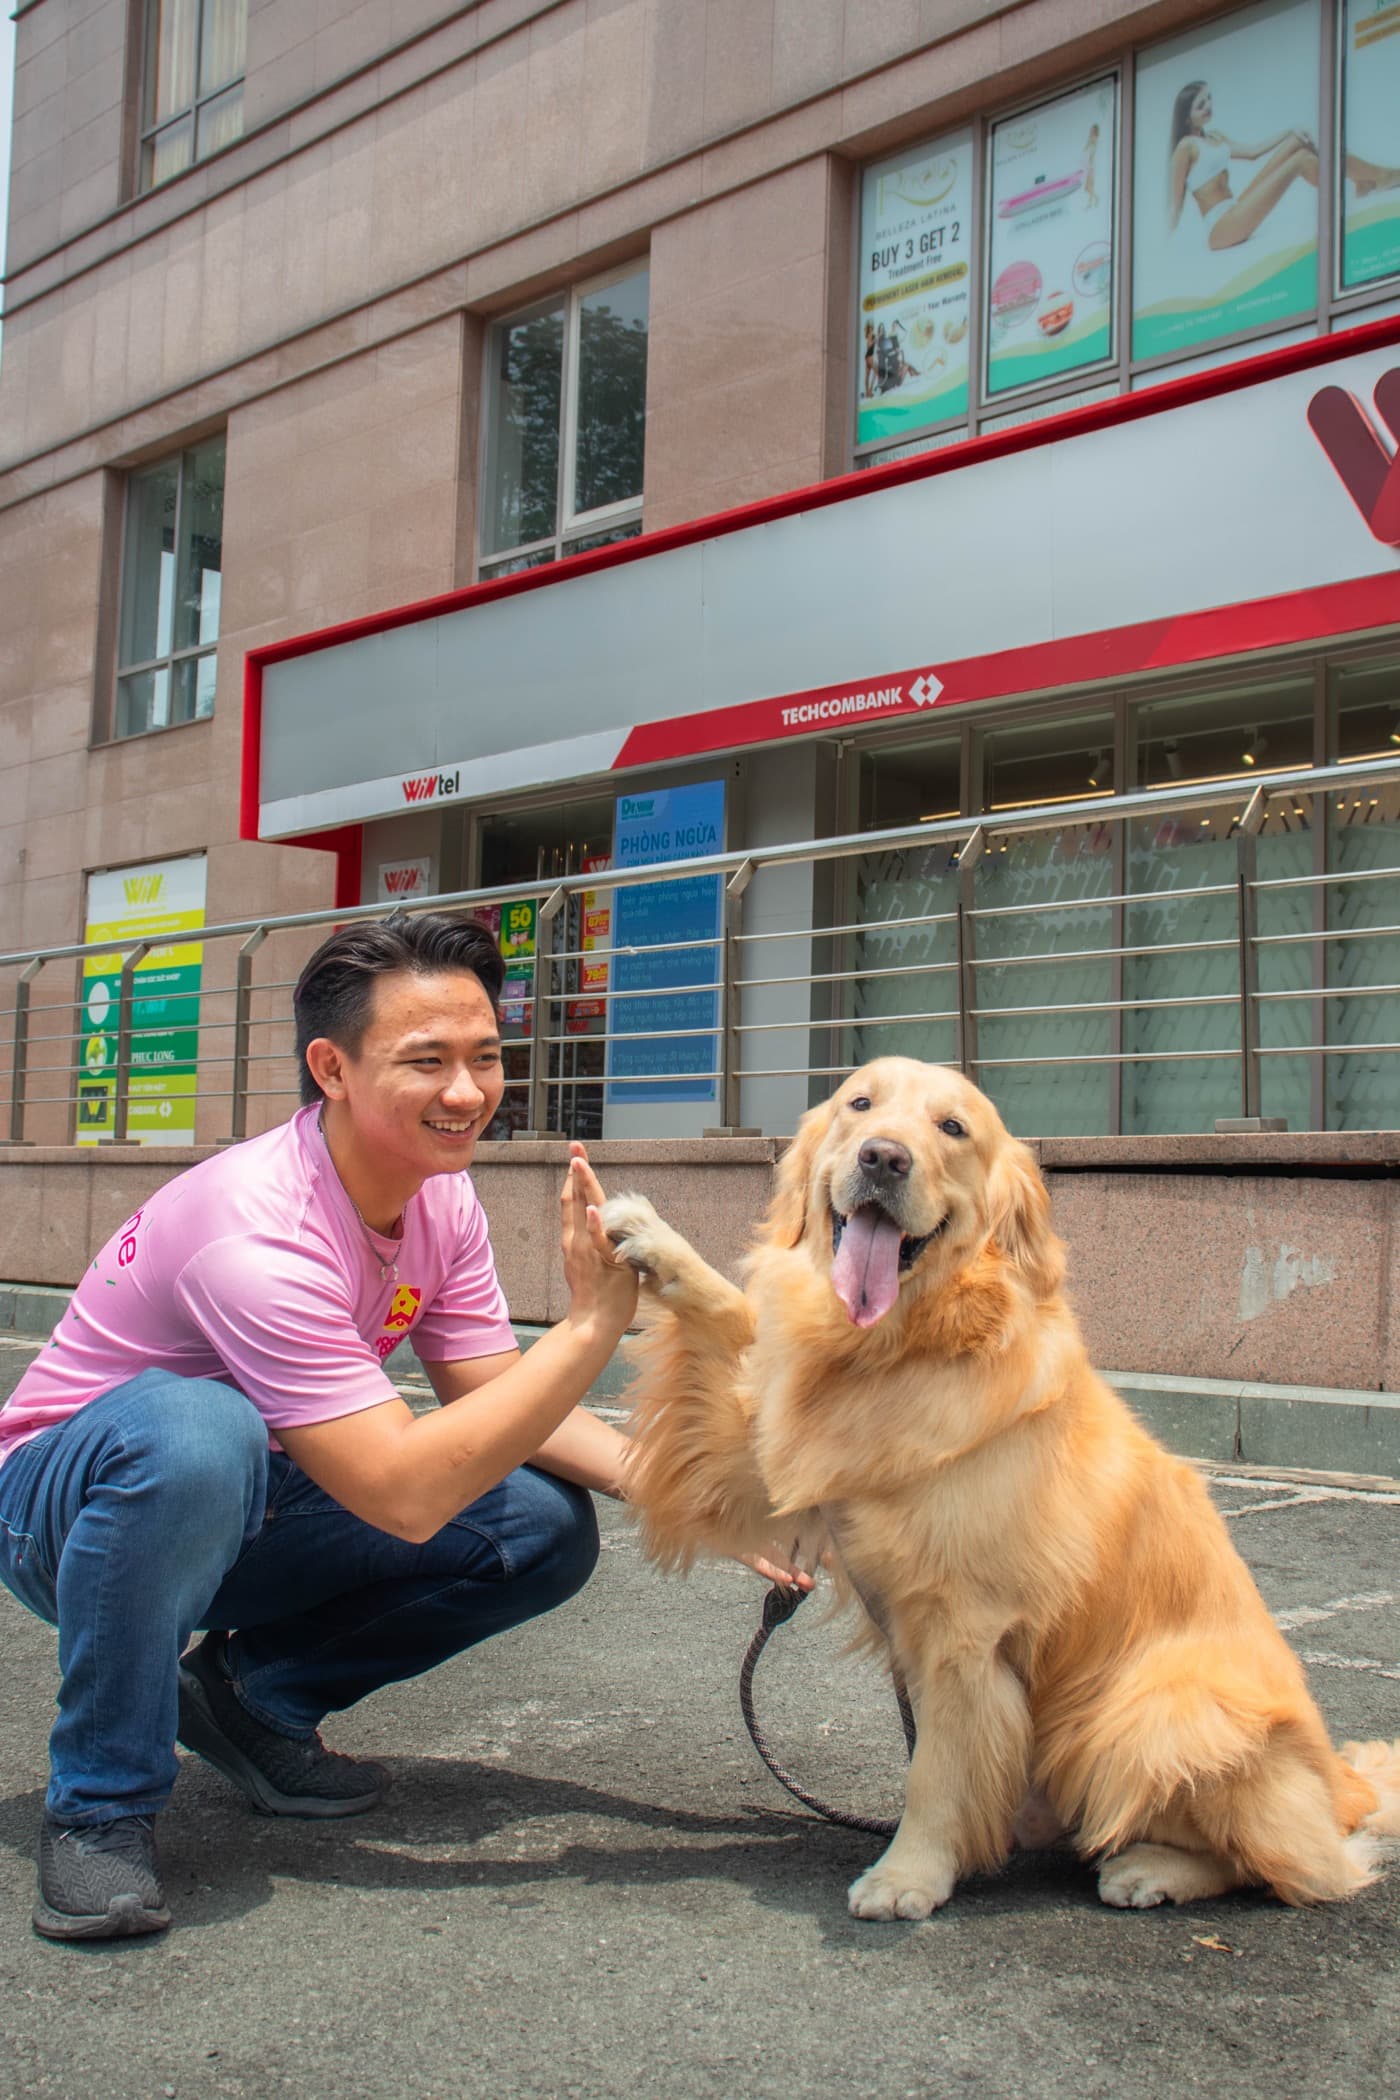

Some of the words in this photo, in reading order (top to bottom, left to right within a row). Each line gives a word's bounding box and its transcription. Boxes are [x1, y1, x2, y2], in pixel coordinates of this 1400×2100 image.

[871, 243, 900, 272] BUY
[905, 238, 914, 260] 3
[919, 226, 946, 254] GET
[951, 221, 960, 243] 2
[887, 259, 924, 281] Treatment
[926, 253, 942, 266] Free
[781, 686, 902, 726] TECHCOMBANK
[620, 830, 670, 856] PHÒNG
[675, 821, 717, 848] NGỪA
[509, 907, 532, 929] 50
